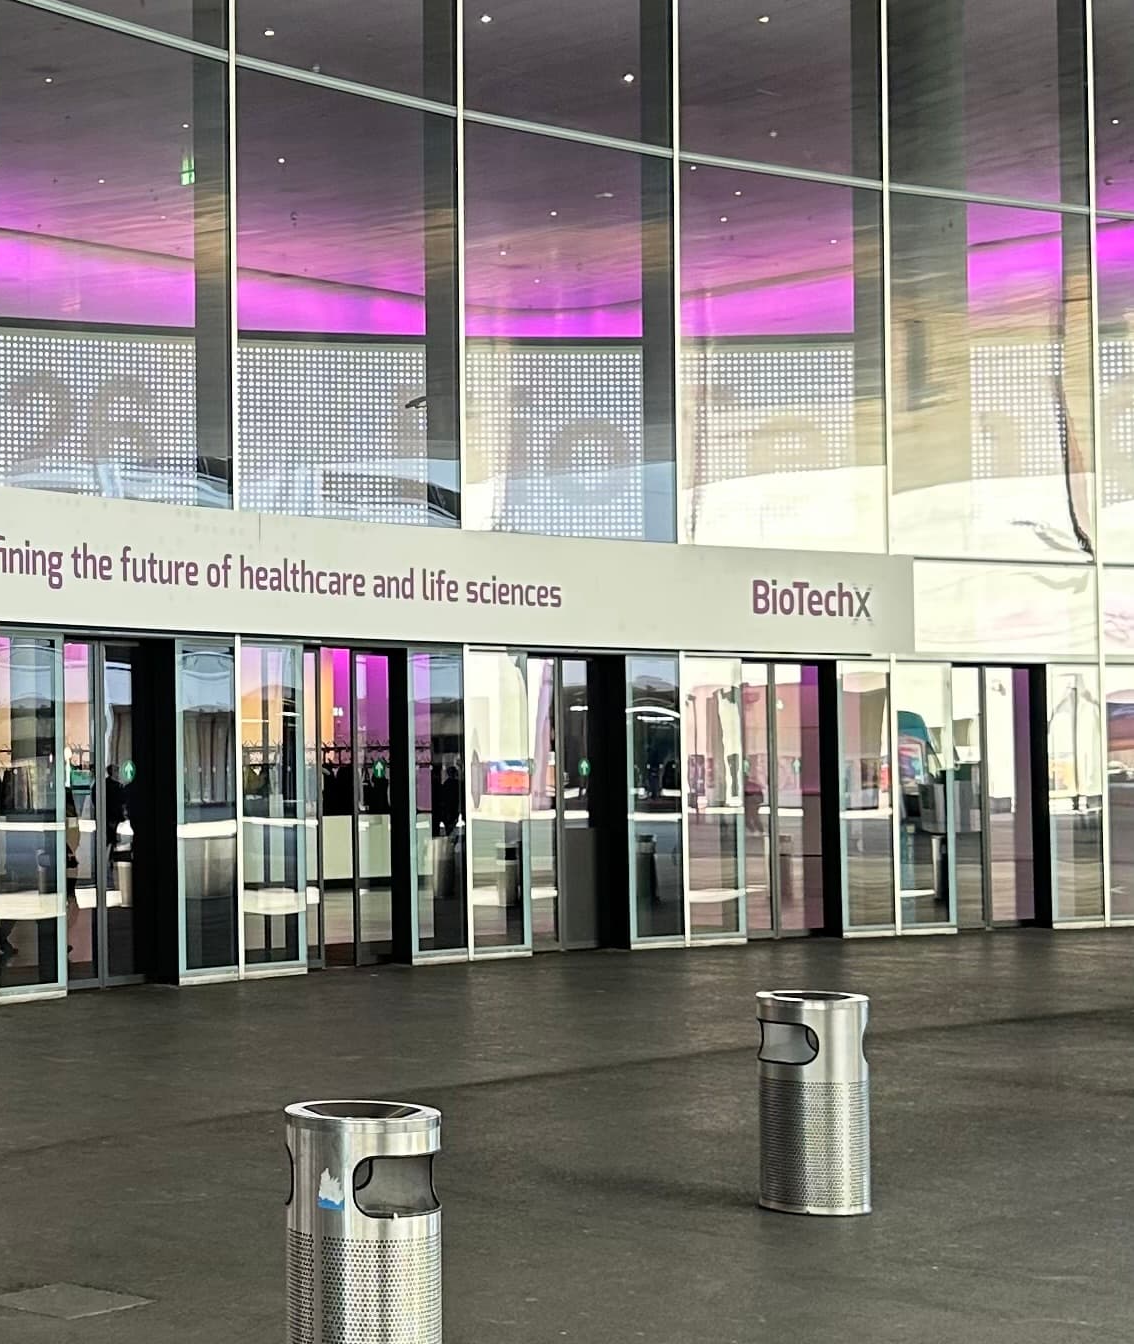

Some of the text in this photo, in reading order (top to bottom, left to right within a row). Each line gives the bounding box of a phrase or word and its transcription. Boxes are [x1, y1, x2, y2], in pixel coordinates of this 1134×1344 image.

[70, 542, 113, 581] the
[119, 545, 199, 587] future
[206, 554, 232, 588] of
[239, 554, 366, 597] healthcare
[373, 568, 415, 600] and
[421, 568, 460, 602] life
[466, 576, 562, 608] sciences
[752, 579, 873, 625] BioTechX
